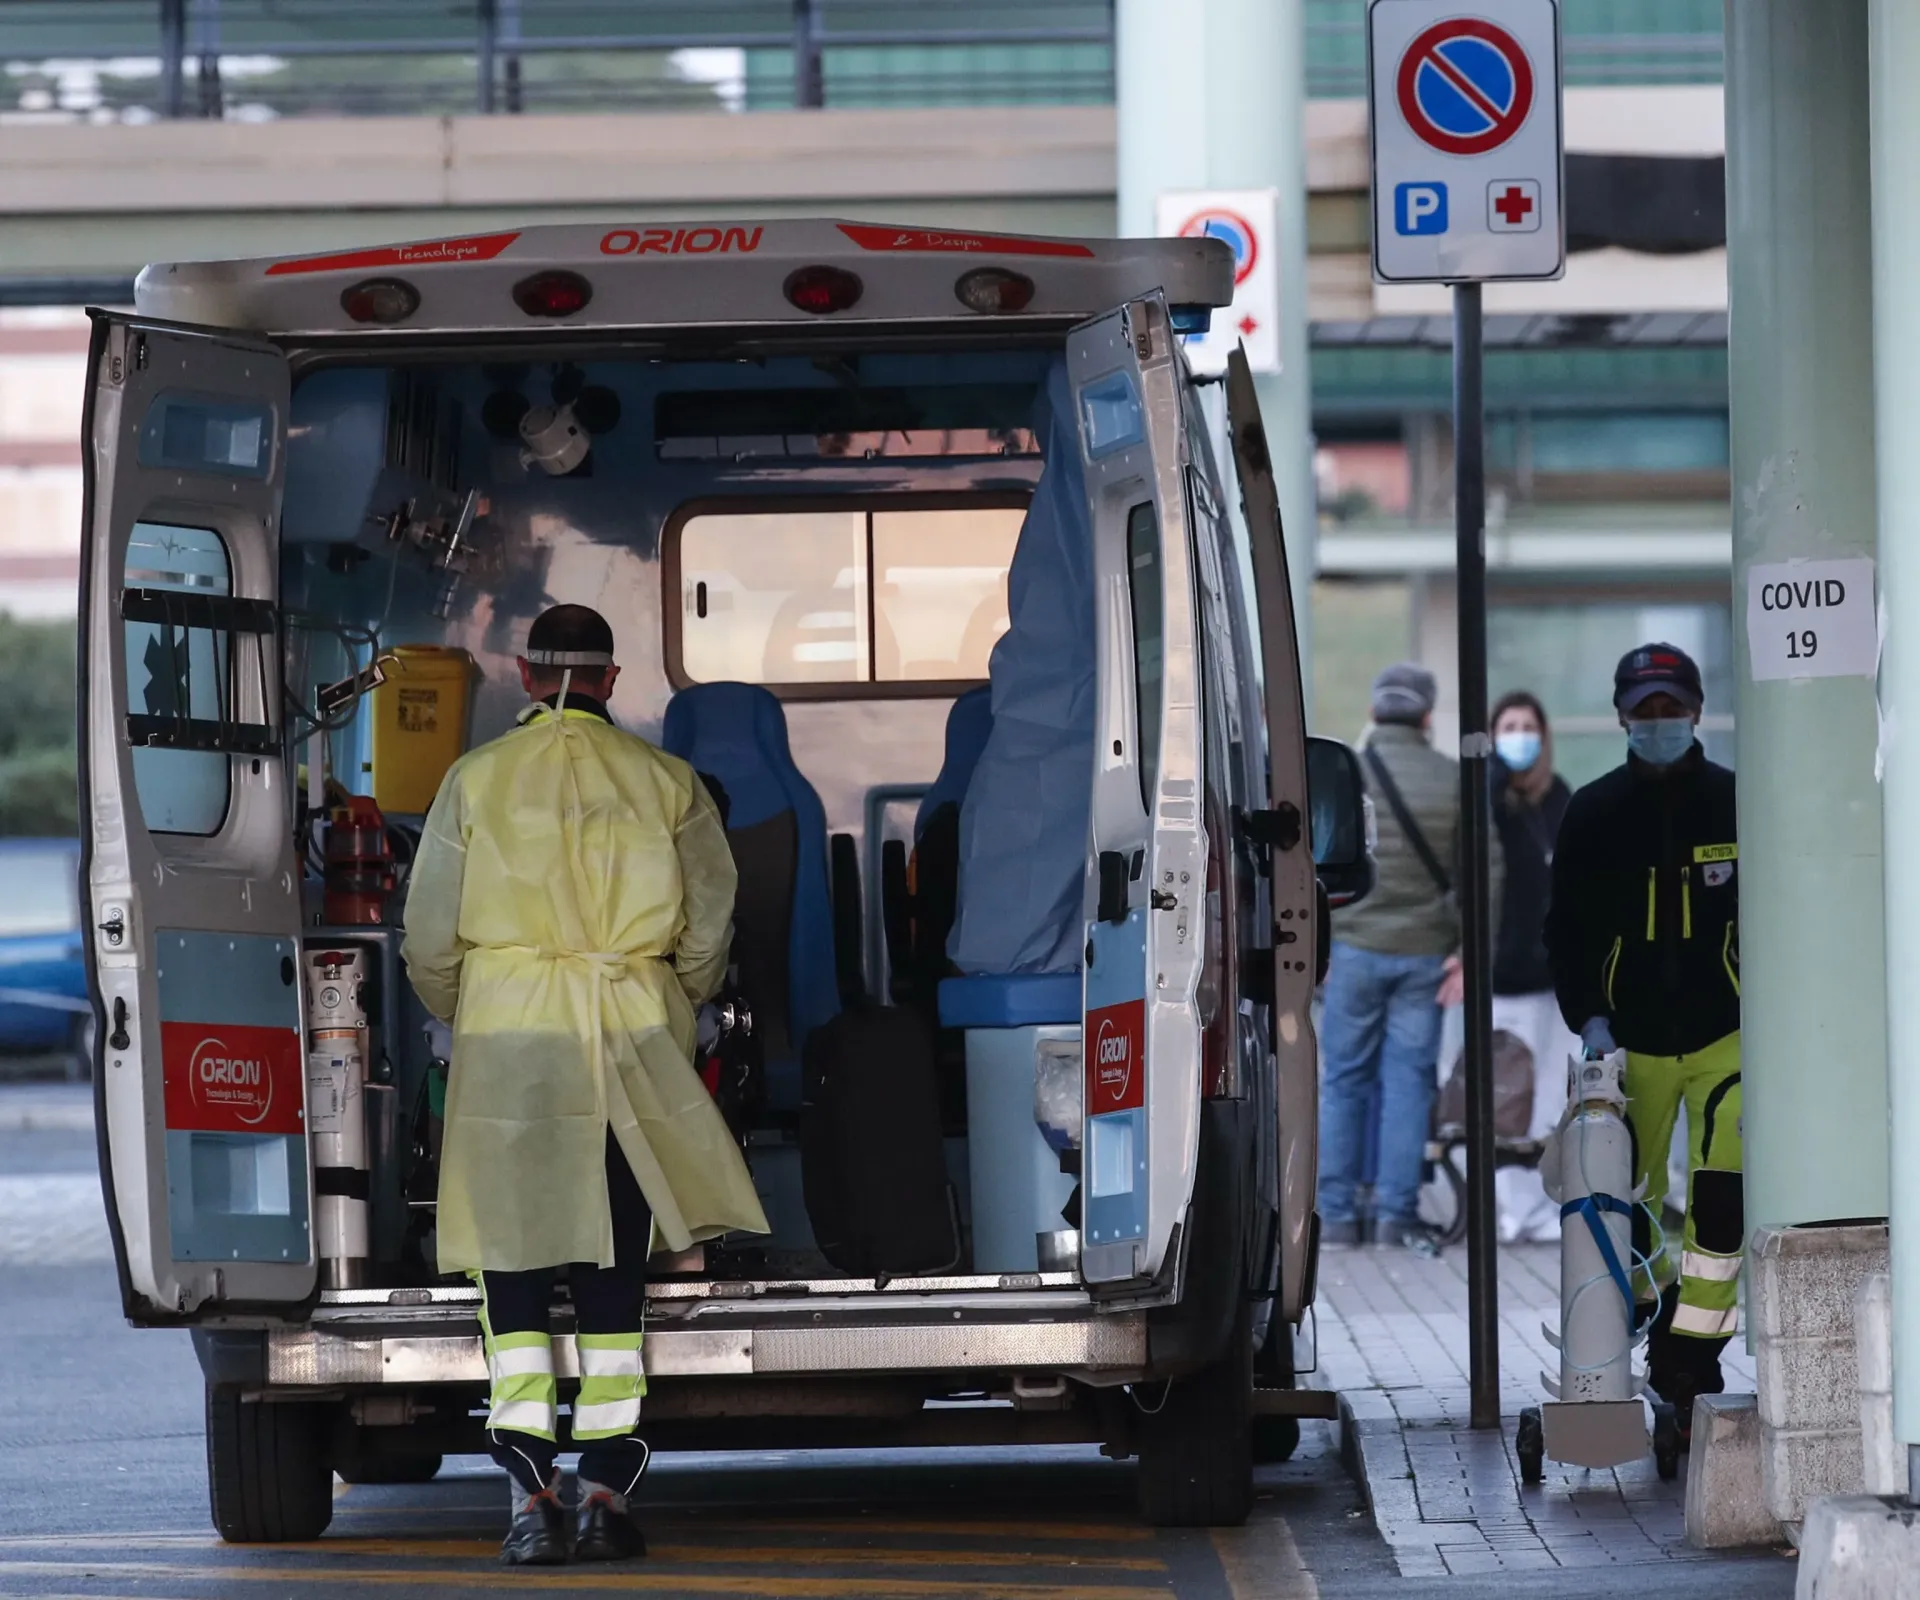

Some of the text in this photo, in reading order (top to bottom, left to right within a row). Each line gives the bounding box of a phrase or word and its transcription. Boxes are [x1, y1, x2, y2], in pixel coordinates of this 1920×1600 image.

[1407, 188, 1440, 230] P
[600, 226, 764, 255] ORION
[1761, 579, 1845, 611] COVID
[1786, 630, 1818, 659] 19
[1100, 1035, 1127, 1064] ORION
[200, 1057, 260, 1085] ORION
